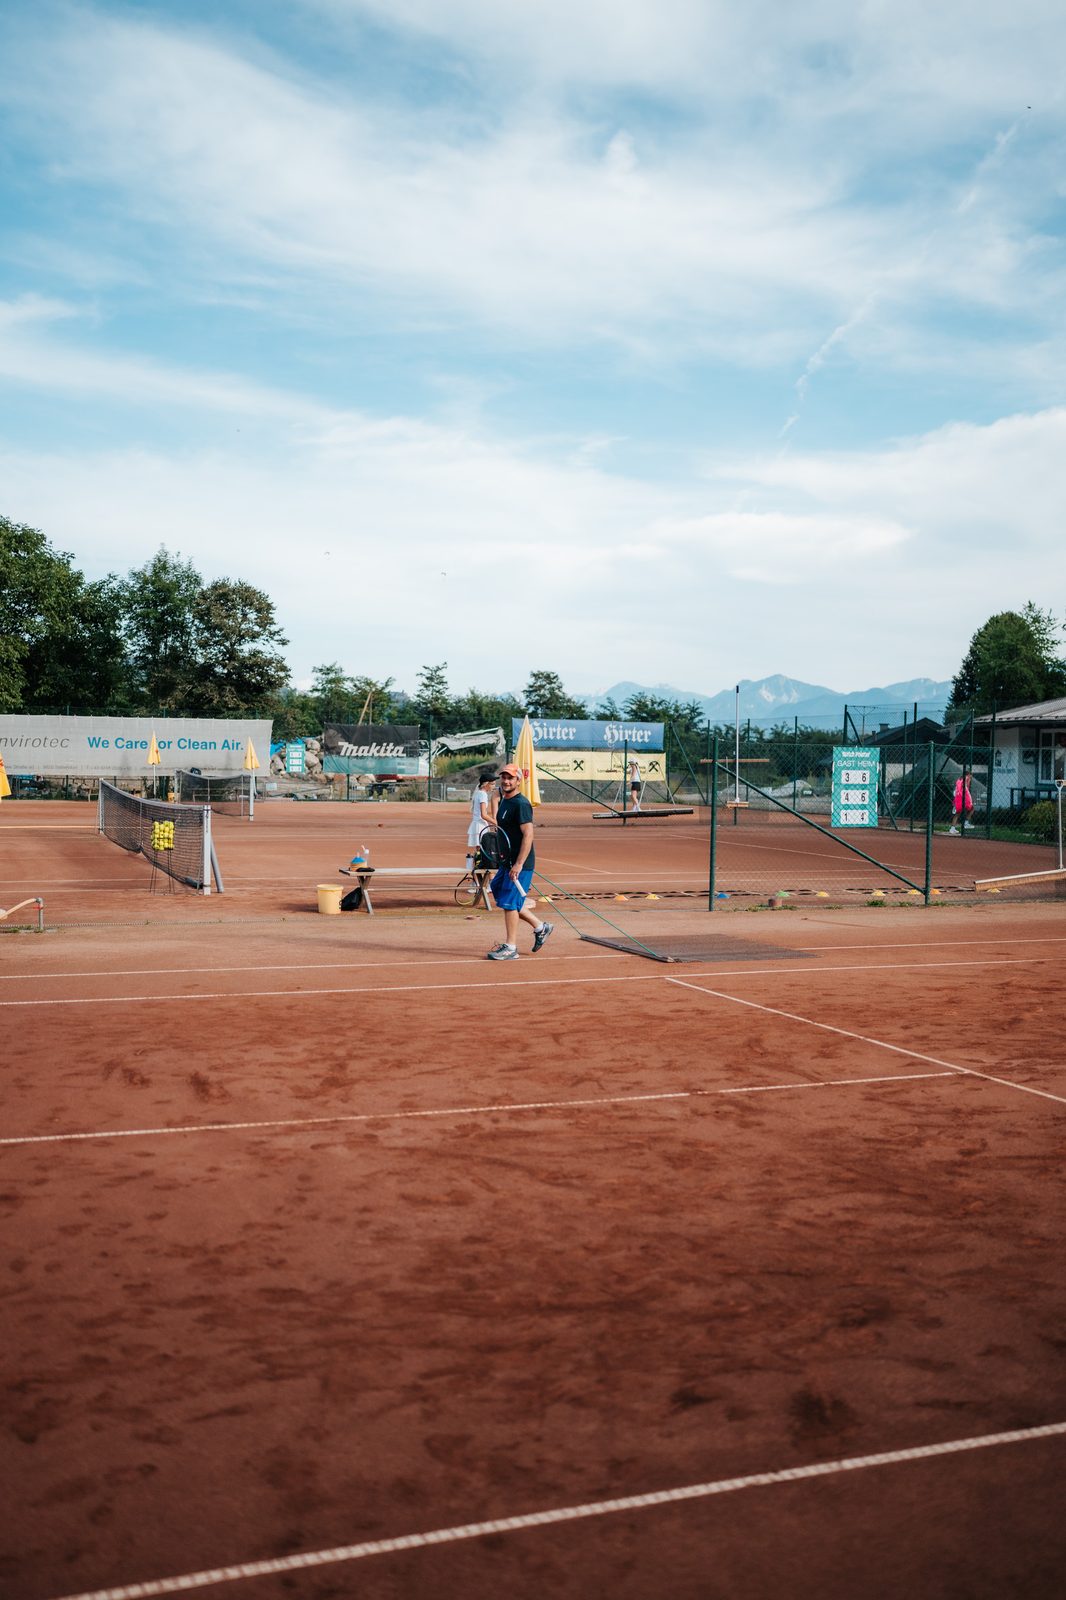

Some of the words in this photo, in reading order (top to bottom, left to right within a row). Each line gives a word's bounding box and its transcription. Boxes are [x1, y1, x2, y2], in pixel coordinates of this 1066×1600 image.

[530, 721, 577, 744] Hirter
[604, 723, 652, 747] Hirter
[87, 736, 110, 749] We
[114, 737, 148, 750] Care
[155, 738, 173, 750] or
[177, 738, 217, 750] Clean
[221, 739, 244, 751] Air.
[845, 772, 850, 782] 3
[861, 772, 867, 782] 6
[844, 792, 849, 801] 4
[861, 792, 866, 802] 6
